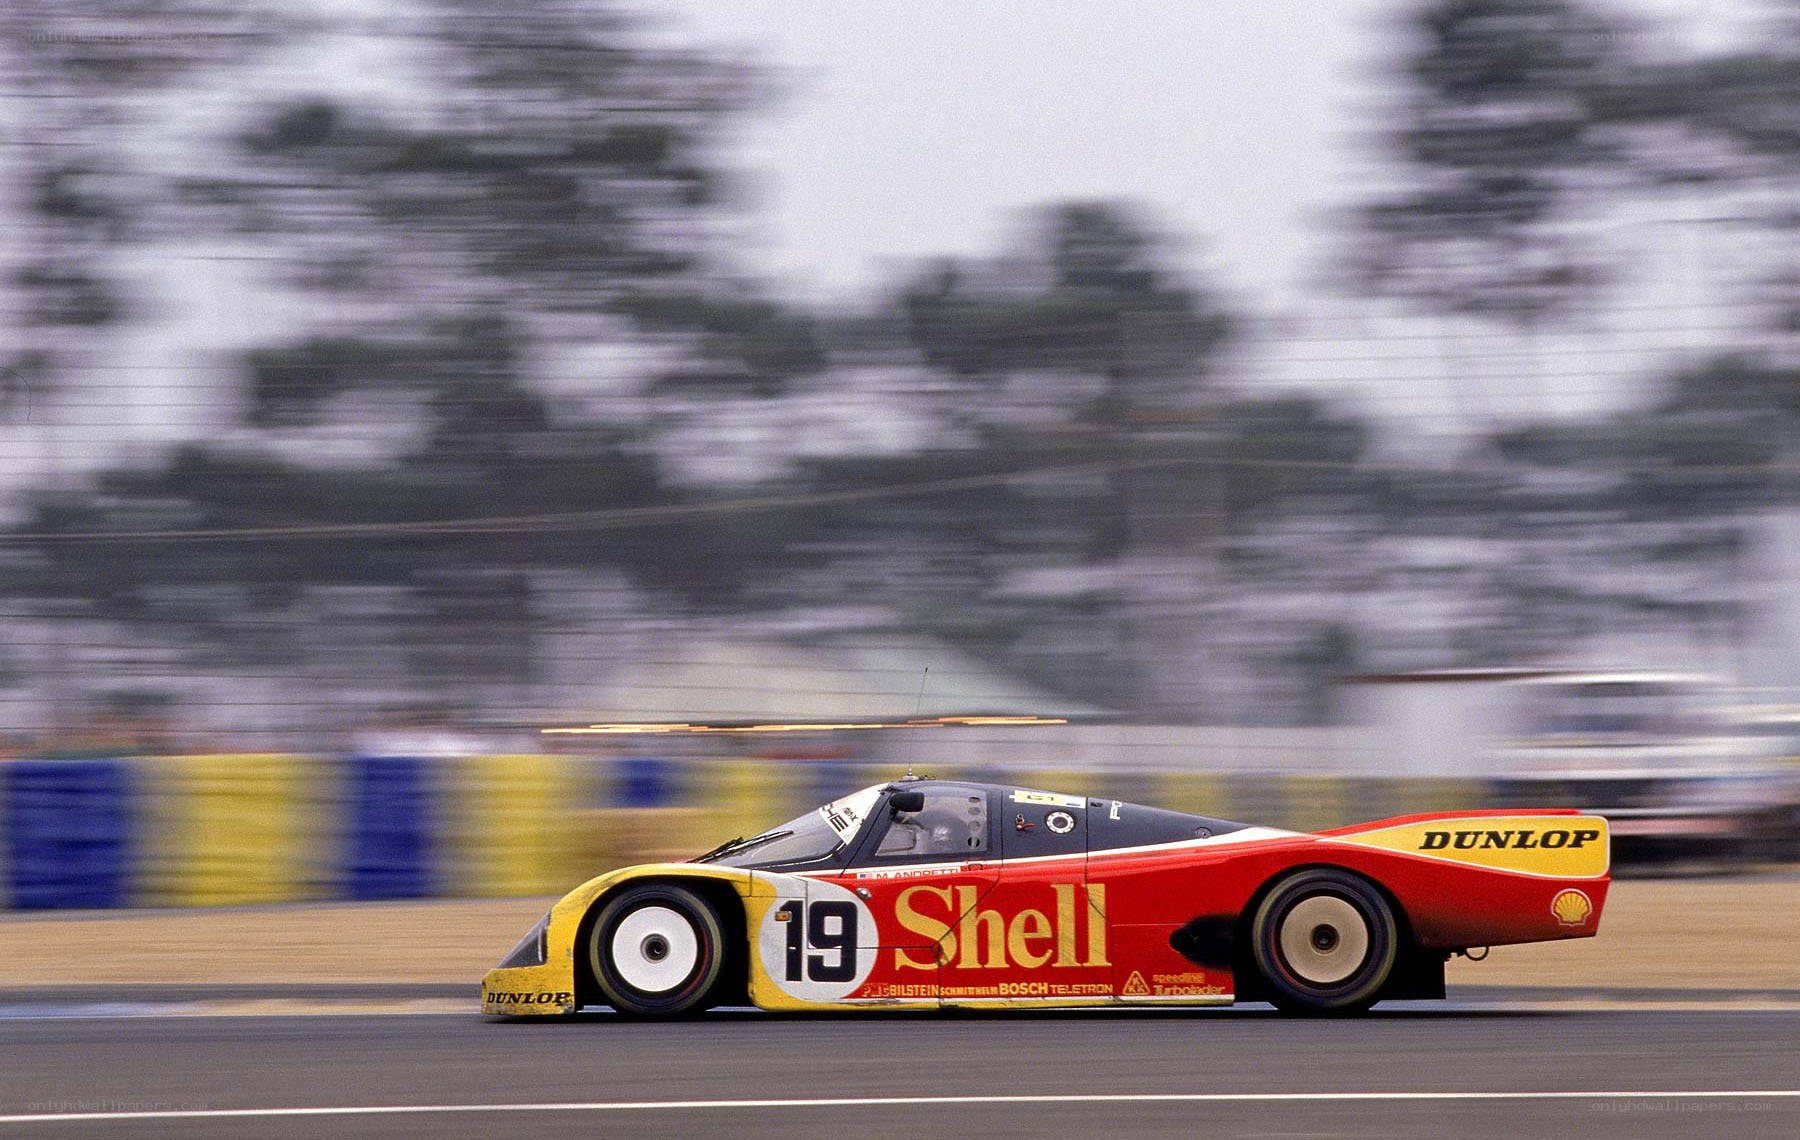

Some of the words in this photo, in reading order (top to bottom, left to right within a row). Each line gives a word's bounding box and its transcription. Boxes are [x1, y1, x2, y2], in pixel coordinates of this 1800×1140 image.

[1418, 830, 1600, 850] DUNLOP
[895, 884, 1113, 971] Shell
[778, 900, 858, 982] 19
[487, 992, 571, 1006] DUNLOP
[889, 984, 939, 996] BILSTEIN
[999, 982, 1048, 995] BOSCH
[1049, 984, 1113, 994] TELETRON
